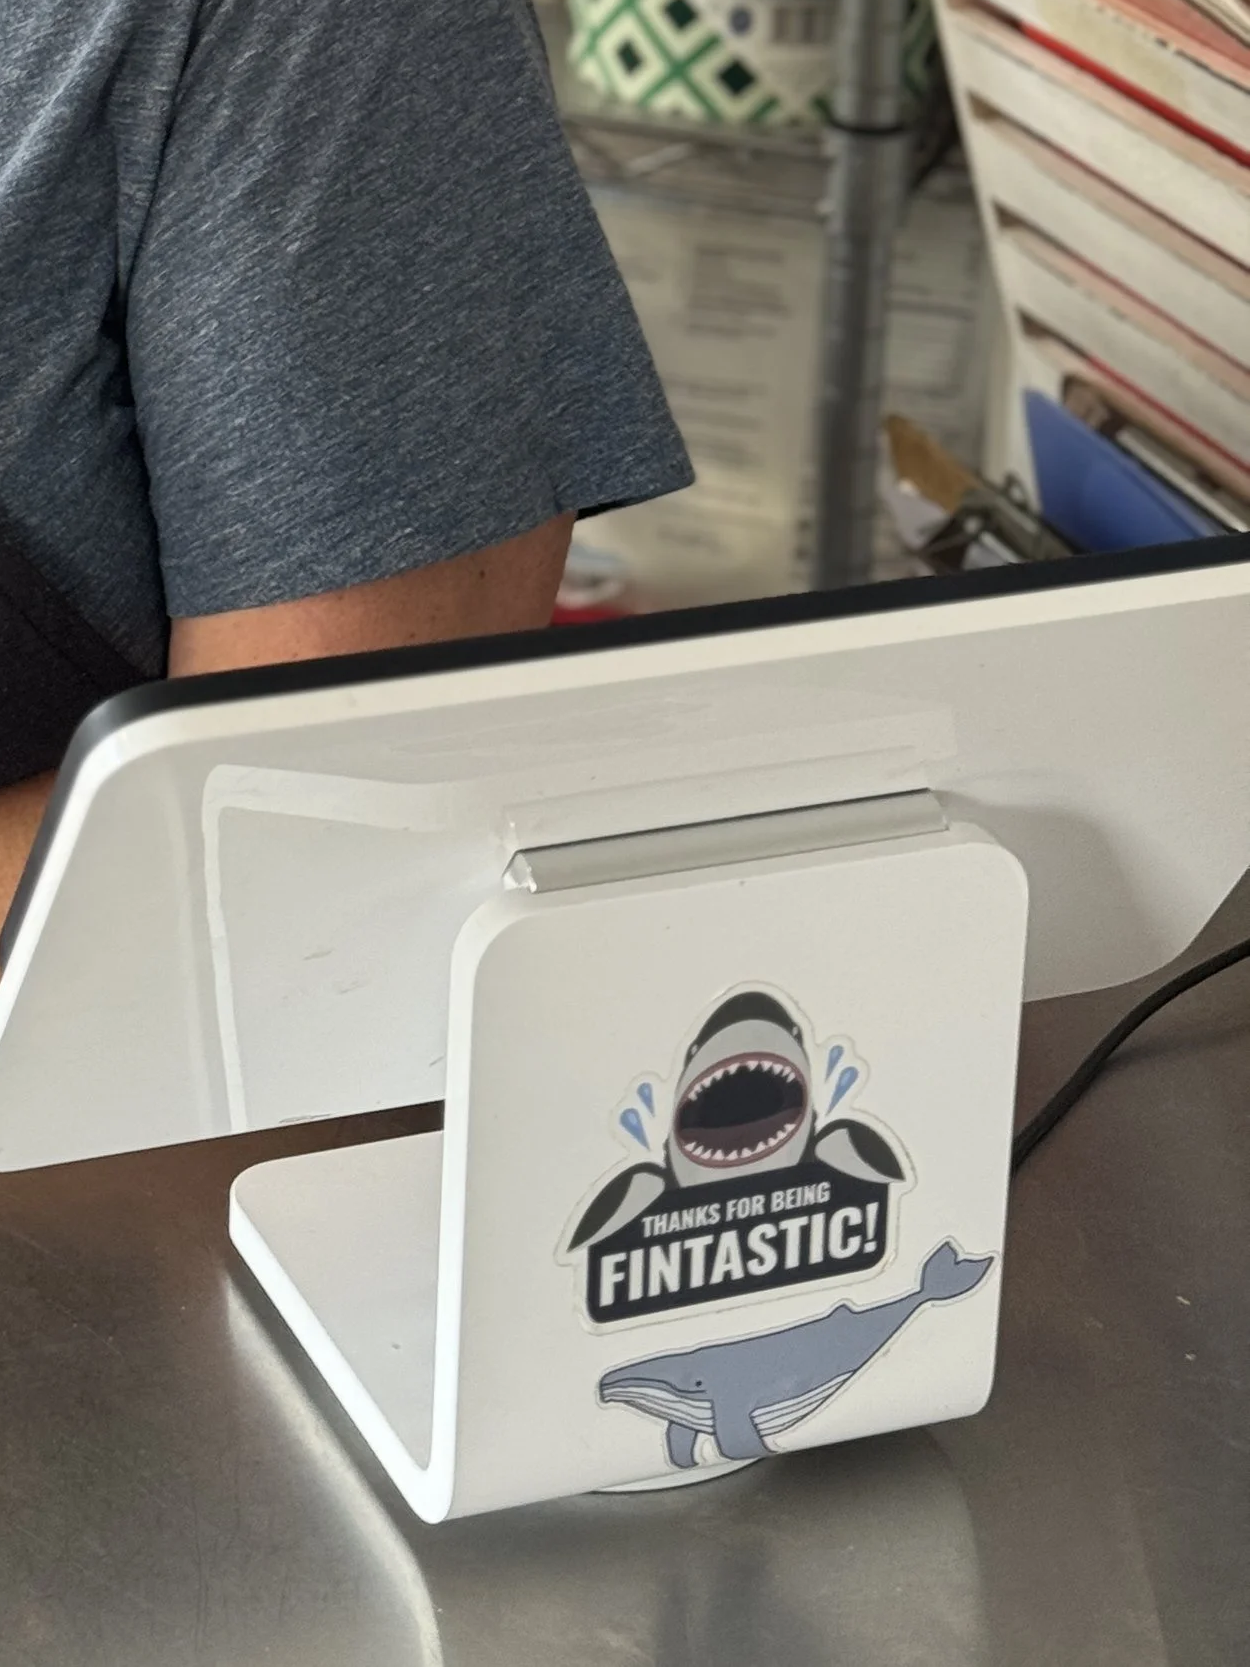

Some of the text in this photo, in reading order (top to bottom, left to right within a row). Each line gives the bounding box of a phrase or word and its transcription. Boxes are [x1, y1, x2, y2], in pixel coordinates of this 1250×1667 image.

[642, 1181, 831, 1238] THANKS FOR BEING
[598, 1201, 880, 1308] FINTASTIC!
